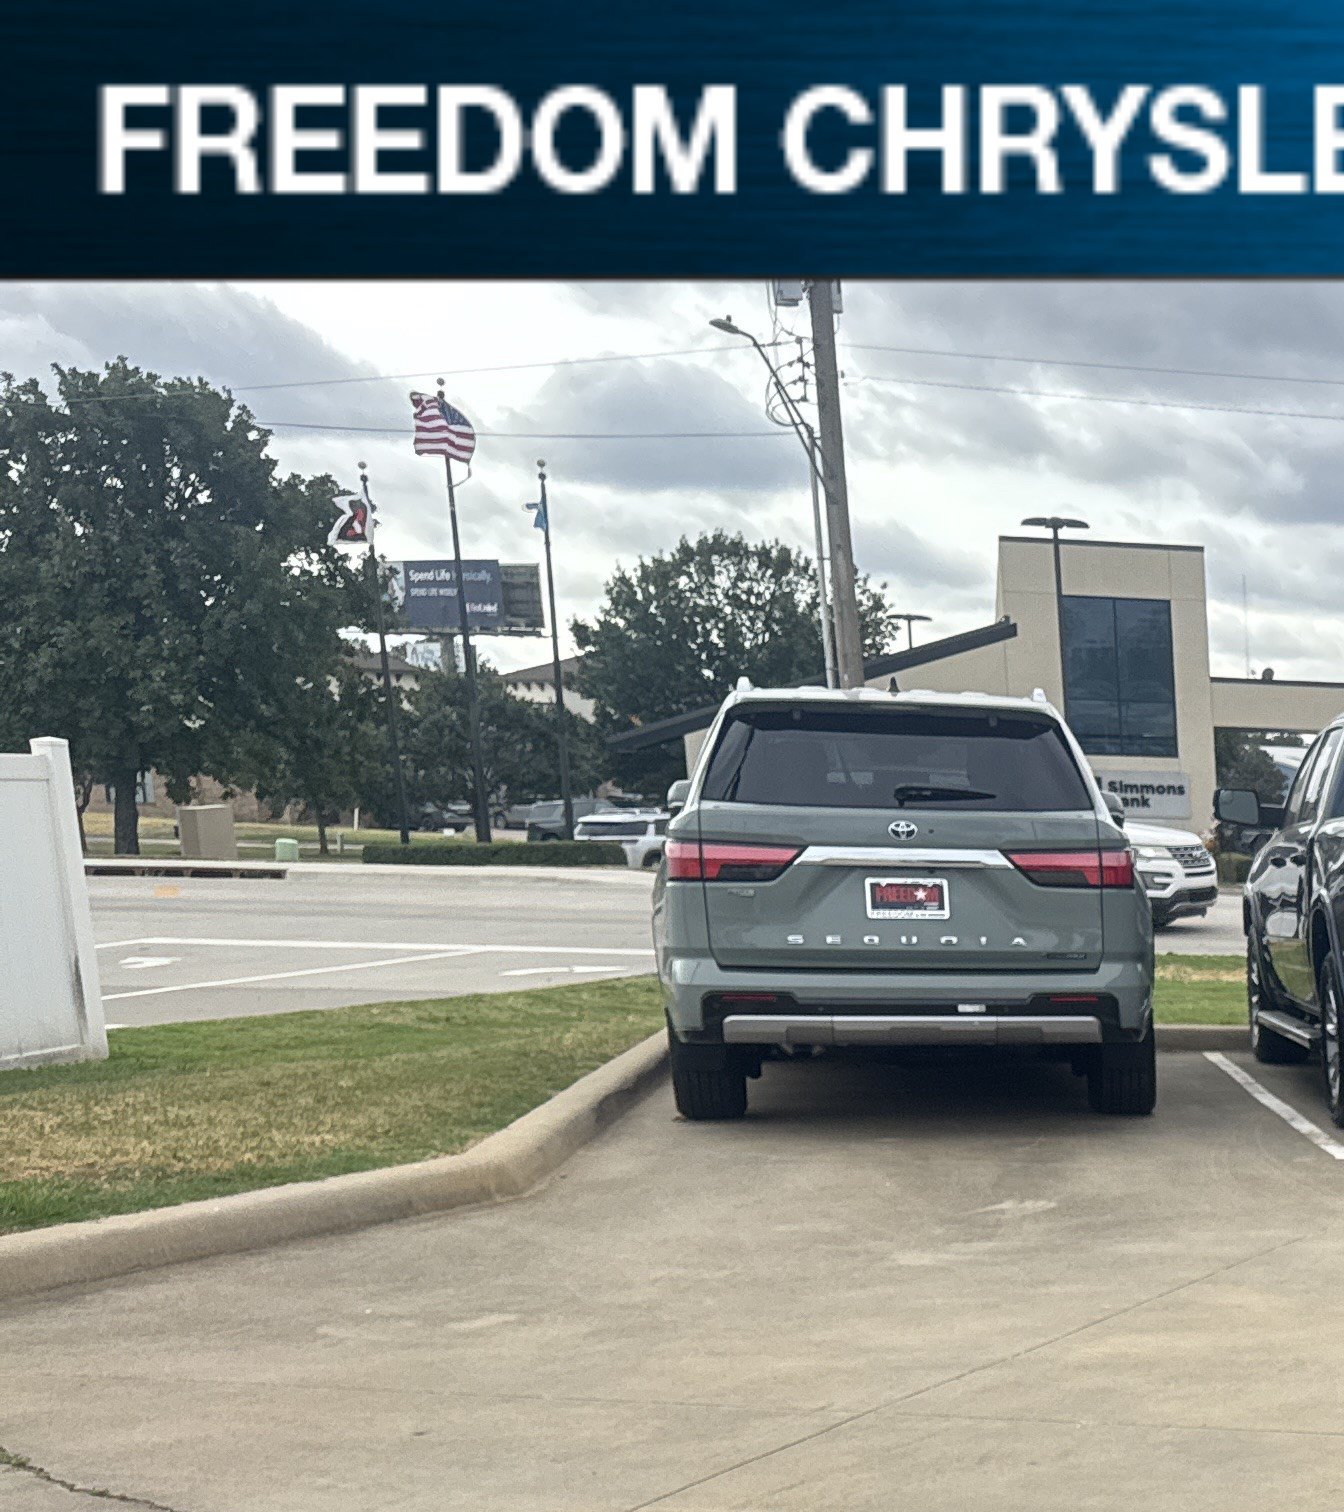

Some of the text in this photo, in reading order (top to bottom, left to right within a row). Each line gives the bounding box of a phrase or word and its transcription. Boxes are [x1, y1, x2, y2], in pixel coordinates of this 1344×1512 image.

[1107, 779, 1186, 796] Simmons
[1120, 795, 1151, 808] ank
[786, 934, 1028, 947] SEQUOIA
